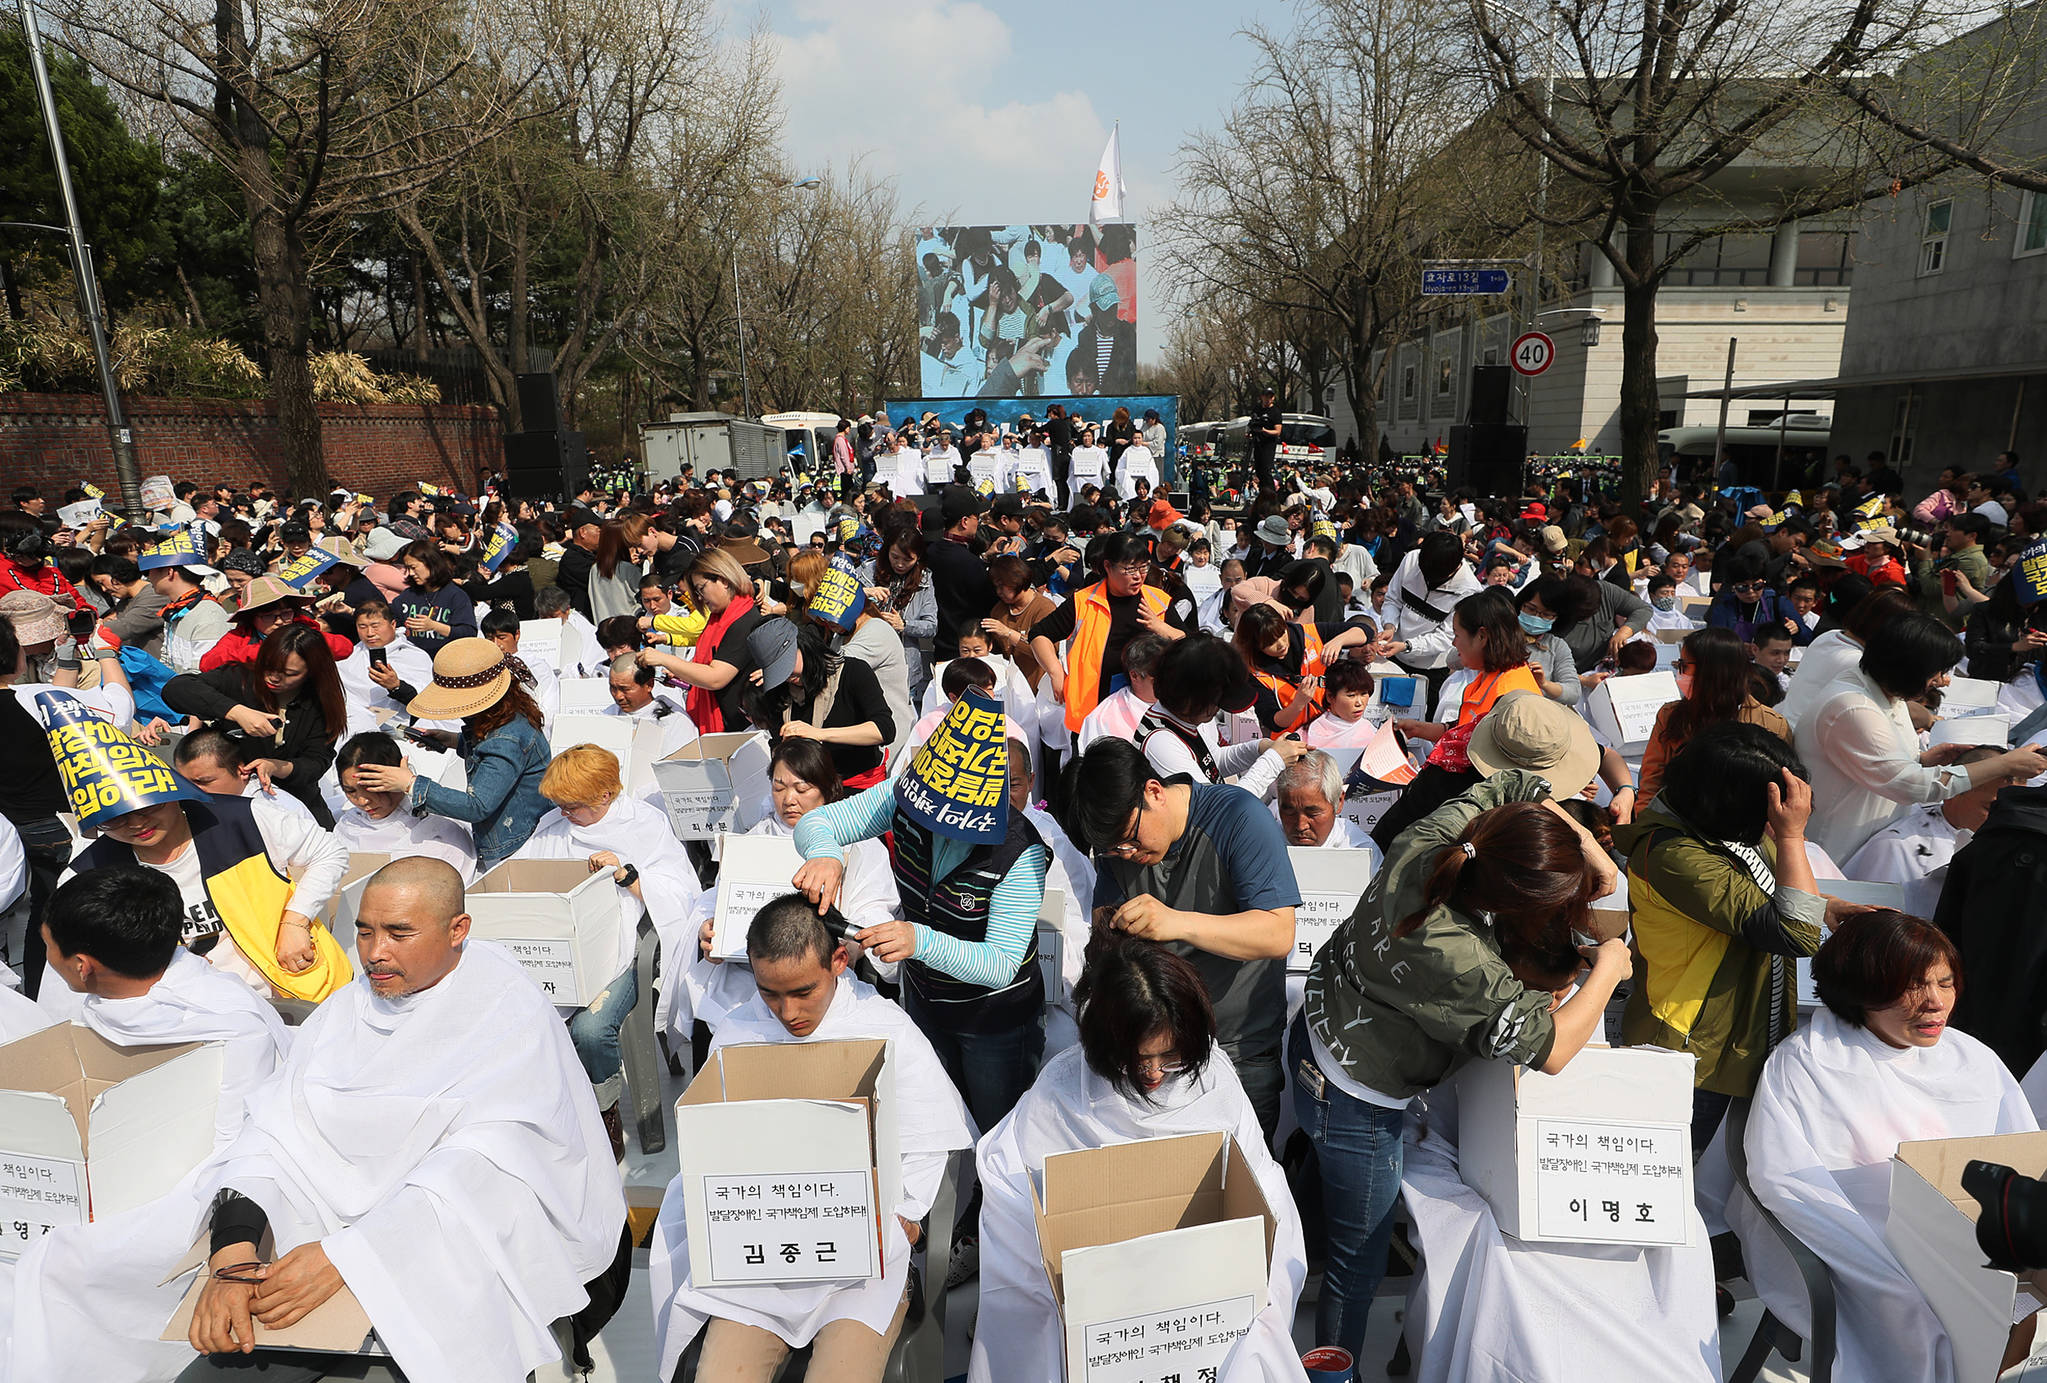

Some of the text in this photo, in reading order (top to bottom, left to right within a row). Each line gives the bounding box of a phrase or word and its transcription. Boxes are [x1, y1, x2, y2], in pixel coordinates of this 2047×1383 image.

[1426, 272, 1480, 284] 효자로13길
[1519, 344, 1544, 364] 40
[936, 803, 997, 832] 국가의
[736, 890, 765, 901] 국가의
[513, 945, 555, 956] 책임이다.
[1298, 942, 1313, 957] 덕
[1546, 1132, 1658, 1154] 국가의 책임이다.
[3, 1163, 56, 1184] 책임이다.
[1539, 1157, 1682, 1179] 발달장애인 국가책임제 도입하라!
[1, 1184, 42, 1202] 국가책임제
[715, 1182, 839, 1201] 국가의 책임이다.
[709, 1204, 867, 1222] 발달장애인 국가책임제 도입하라!
[1096, 1311, 1226, 1346] 국가의 책임이다.
[1088, 1347, 1144, 1368] 발달장애인
[1148, 1336, 1203, 1356] 국가책임제
